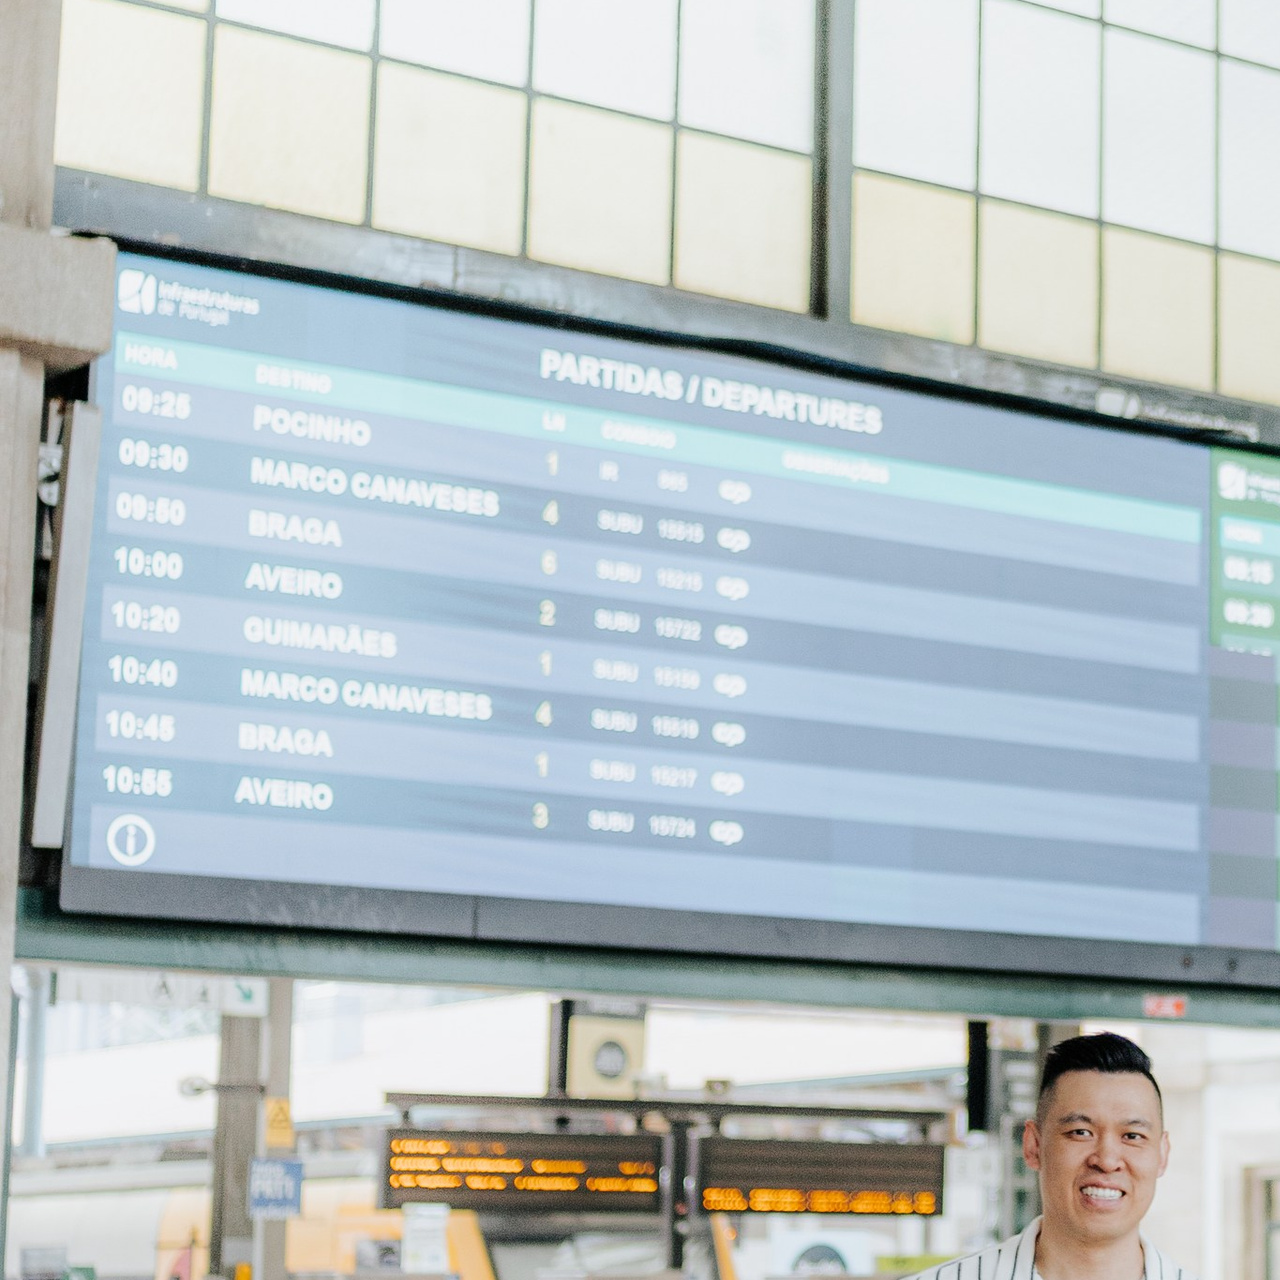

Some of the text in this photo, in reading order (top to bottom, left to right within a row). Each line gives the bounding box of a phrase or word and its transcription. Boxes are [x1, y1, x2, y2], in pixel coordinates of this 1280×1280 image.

[123, 341, 178, 370] HORA
[256, 364, 332, 394] DESTINO
[540, 349, 884, 435] PARTIDAS / DEPARTURES
[122, 384, 191, 420] 09:25
[253, 404, 371, 447] POCINHO
[118, 438, 189, 473] 09:30
[251, 457, 347, 496] MARCO
[350, 471, 499, 517] CANAVESES
[116, 492, 186, 526] 09:50
[249, 509, 342, 548] BRAGA
[114, 546, 183, 580] 10:00
[245, 563, 343, 599] AVEIRO
[540, 600, 556, 626] 2
[111, 600, 181, 634] 10:20
[244, 616, 397, 658] GUIMARÃES
[108, 654, 178, 688] 10:40
[241, 668, 339, 705] MARCO
[341, 680, 492, 721] CANAVESES
[105, 709, 175, 743] 10:45
[239, 722, 333, 758] BRAGA
[103, 764, 172, 797] 10:55
[235, 776, 333, 811] AVEIRO
